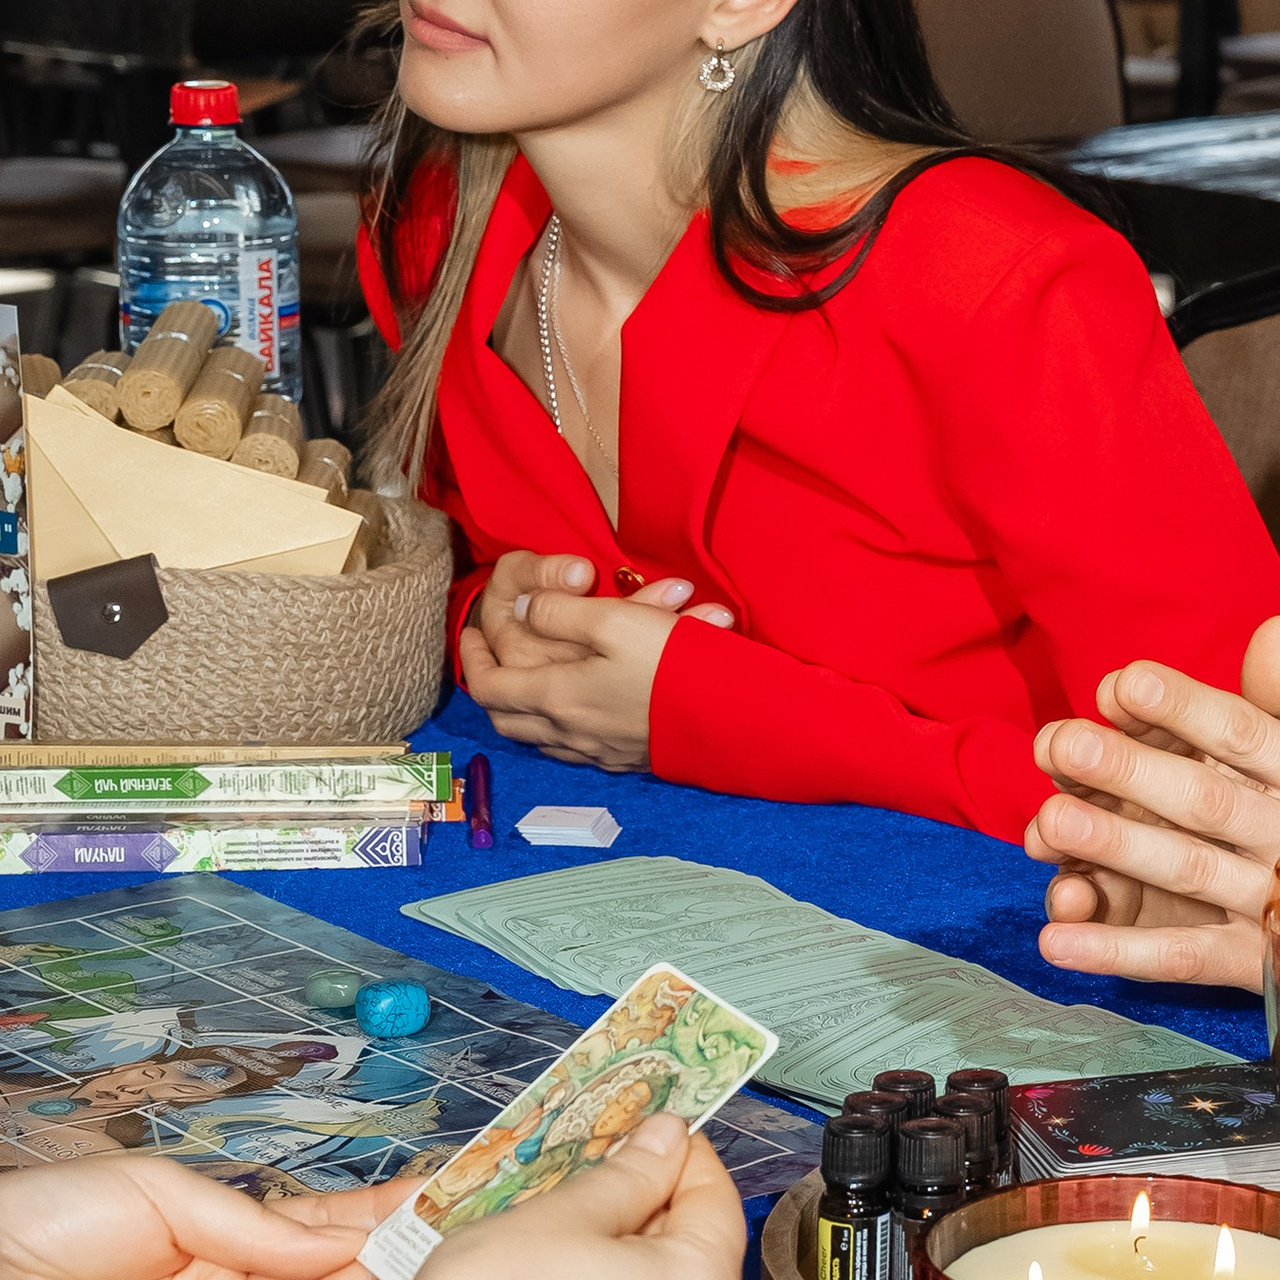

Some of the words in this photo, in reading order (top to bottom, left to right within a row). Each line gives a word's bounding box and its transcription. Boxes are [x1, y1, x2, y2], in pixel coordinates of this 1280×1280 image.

[94, 777, 118, 794] ЧАЙ
[119, 777, 173, 794] ЗЕЛЕНЫЙ
[74, 846, 125, 863] ПАЧУЛИ
[820, 1246, 828, 1280] Cheer
